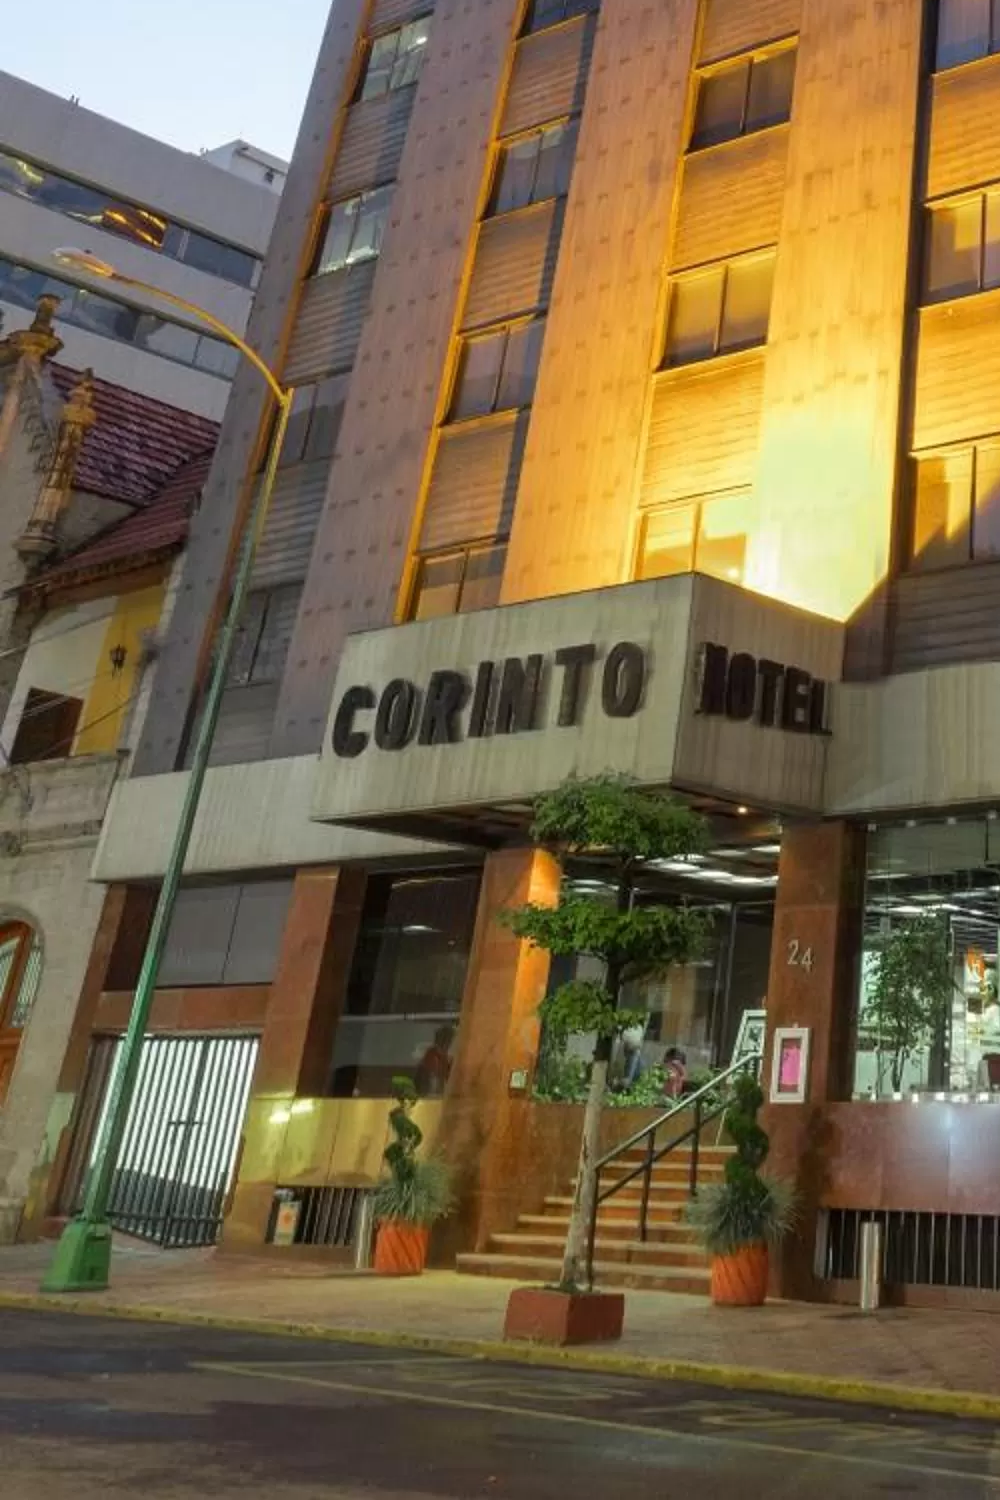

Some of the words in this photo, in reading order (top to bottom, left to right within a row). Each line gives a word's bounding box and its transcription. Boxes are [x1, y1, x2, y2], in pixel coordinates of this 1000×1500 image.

[332, 641, 652, 758] CORINTO
[695, 641, 832, 736] HOTEL
[787, 939, 813, 973] 24
